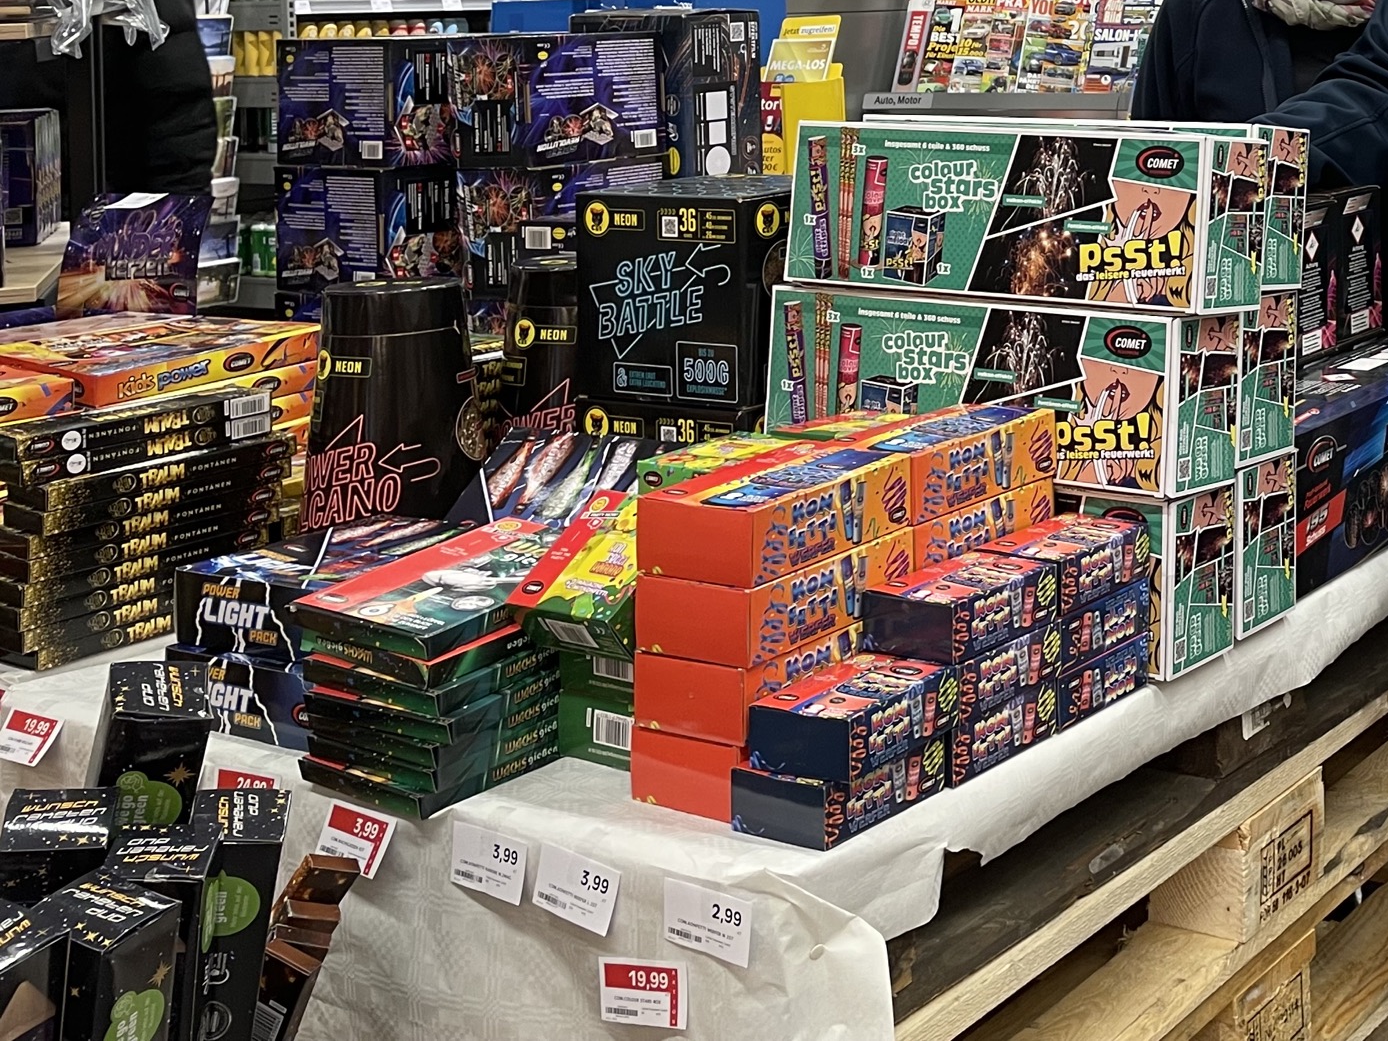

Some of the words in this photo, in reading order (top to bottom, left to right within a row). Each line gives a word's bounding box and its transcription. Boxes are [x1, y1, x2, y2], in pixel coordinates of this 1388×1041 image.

[770, 59, 826, 70] MEGA-LOS
[874, 96, 896, 105] Auto,
[898, 96, 921, 104] Motor
[952, 143, 965, 151] 360
[966, 144, 990, 152] schuss
[910, 160, 976, 182] colour
[1147, 158, 1179, 170] COMET
[930, 177, 998, 200] stars
[924, 193, 962, 211] box
[614, 213, 637, 226] NEON
[679, 208, 696, 232] 36
[615, 252, 676, 297] SKY
[1076, 270, 1095, 281] das
[1096, 270, 1129, 281] leisere
[1131, 266, 1186, 278] feuerwerk!
[598, 286, 703, 340] BATTLE
[936, 315, 961, 324] schuss
[540, 329, 567, 340] NEON
[883, 330, 948, 352] colour
[1114, 337, 1146, 351] COMET
[335, 360, 362, 373] NEON
[902, 349, 970, 371] stars
[117, 372, 156, 400] Kids
[157, 358, 211, 390] power
[896, 362, 936, 383] box
[613, 420, 637, 434] NEON
[677, 419, 695, 443] 36
[948, 441, 987, 472] KON
[1065, 450, 1100, 459] leisere
[1100, 448, 1155, 459] feuerwerk!
[1314, 448, 1334, 467] COMET
[139, 463, 185, 488] TRAUM
[192, 456, 237, 473] FONTÄNEN
[134, 487, 180, 511] TRAUM
[186, 480, 231, 496] FONTÄNEN
[790, 491, 835, 521] KON
[122, 511, 169, 536] TRAUM
[176, 503, 222, 519] FONTÄNEN
[202, 583, 240, 599] POWER
[790, 569, 835, 600] KON
[202, 597, 269, 629] LIGHT
[250, 630, 278, 644] PACK
[24, 718, 50, 735] 19,99
[234, 713, 262, 729] PACK
[353, 818, 379, 839] 3,99
[492, 844, 518, 866] 3,99
[580, 870, 609, 895] 3,99
[711, 903, 742, 927] 2,99
[627, 970, 669, 990] 19,99
